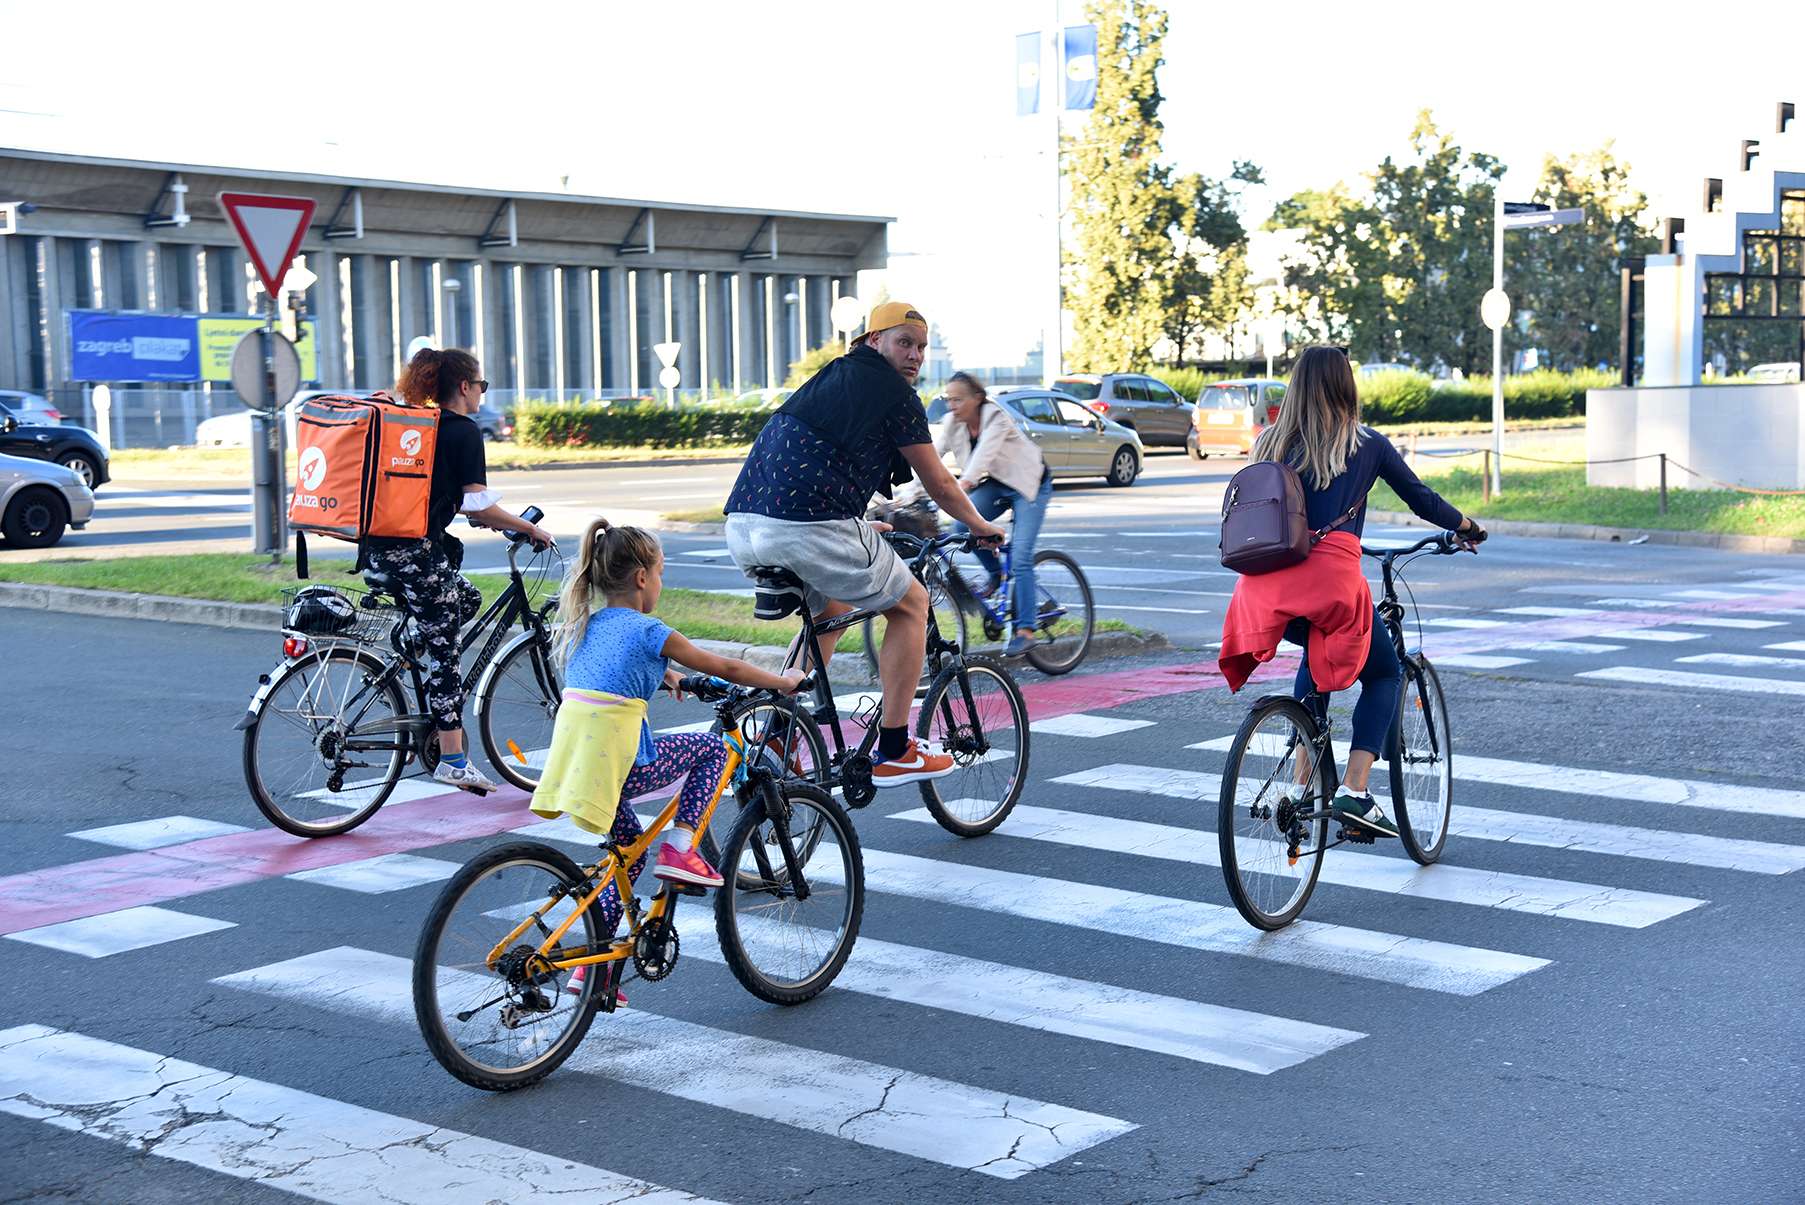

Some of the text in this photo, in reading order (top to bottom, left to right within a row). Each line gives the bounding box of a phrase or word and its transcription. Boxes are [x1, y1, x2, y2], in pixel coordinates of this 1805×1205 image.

[77, 338, 132, 356] zagreb
[391, 457, 425, 467] pauza go
[293, 494, 337, 511] auza go
[467, 621, 507, 687] Kalkhoff
